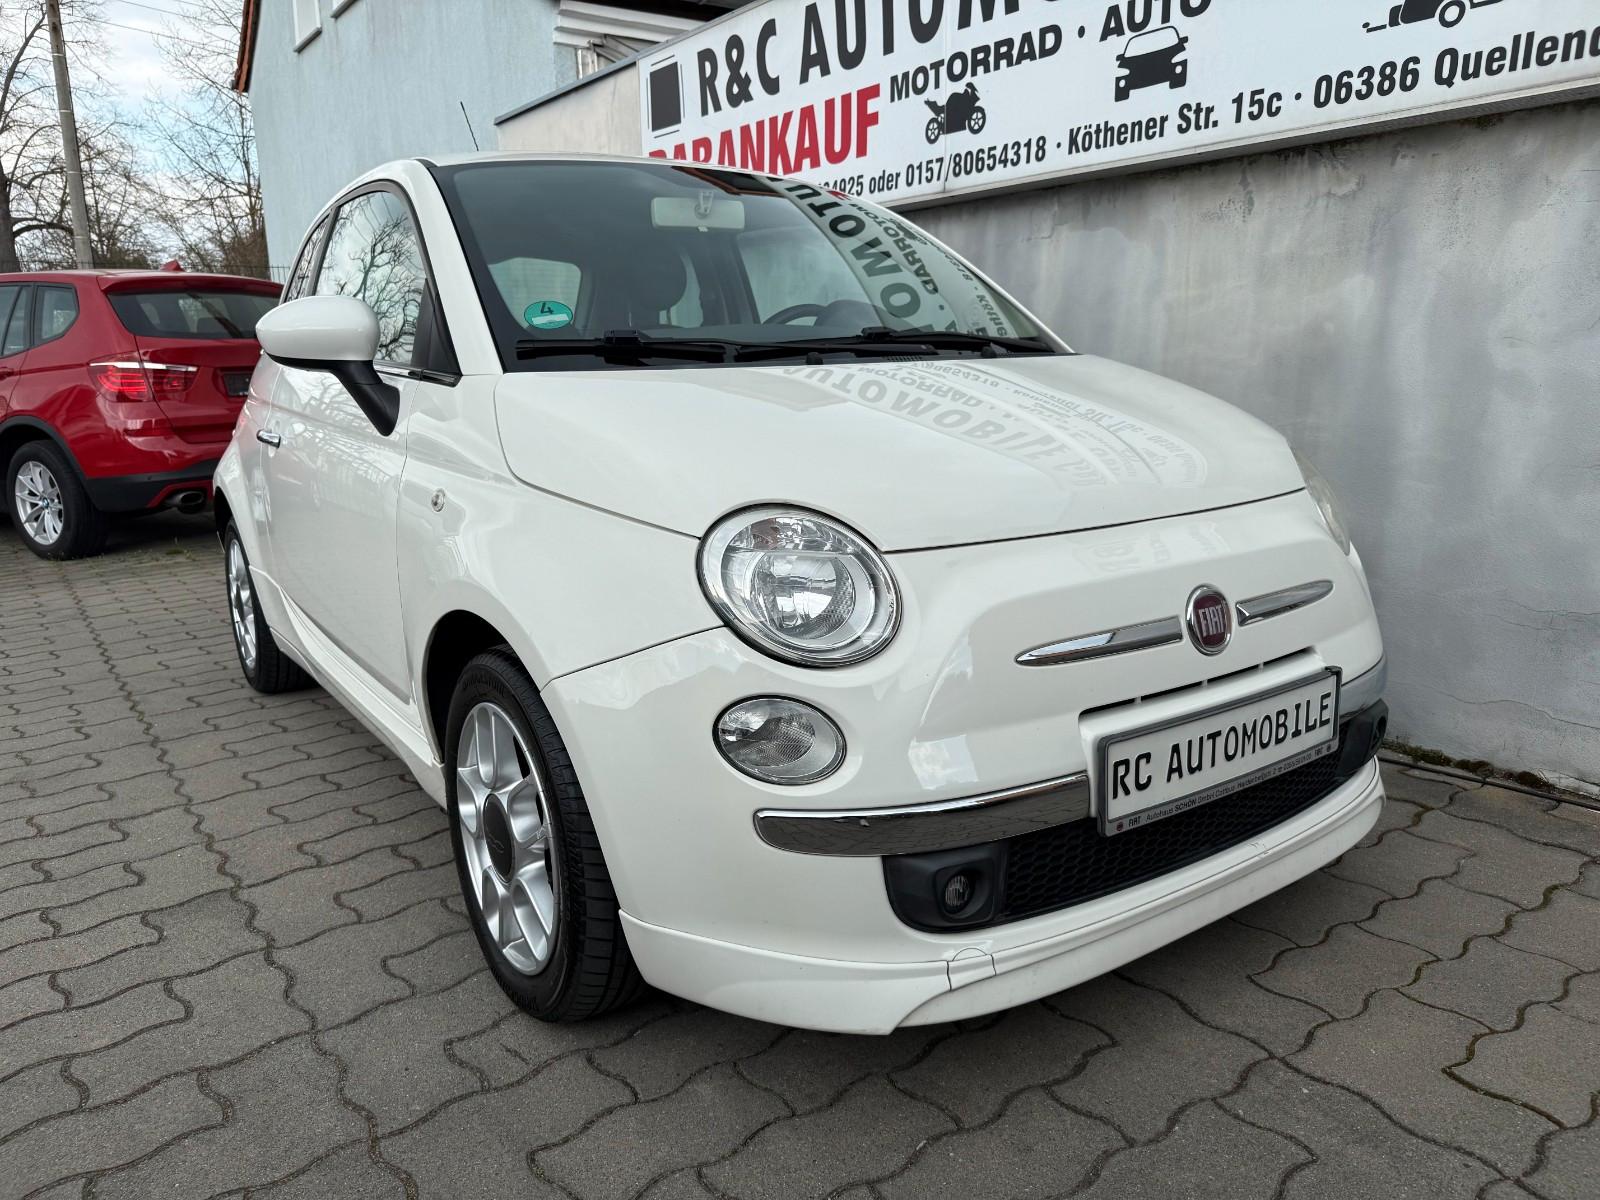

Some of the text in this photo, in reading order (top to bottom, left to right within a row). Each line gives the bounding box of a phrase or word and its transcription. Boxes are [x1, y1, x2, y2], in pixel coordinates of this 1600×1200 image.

[697, 18, 780, 117] R&C
[890, 24, 1063, 103] MOTORRAD
[869, 169, 901, 194] oder
[905, 135, 1047, 188] 0157/80654318
[1067, 113, 1169, 155] Köthener
[1177, 102, 1219, 134] Str.
[1231, 88, 1282, 124] 15c
[1313, 56, 1420, 109] 06386
[1198, 604, 1224, 638] FIAT
[1112, 691, 1332, 800] RC AUTOMOBILE
